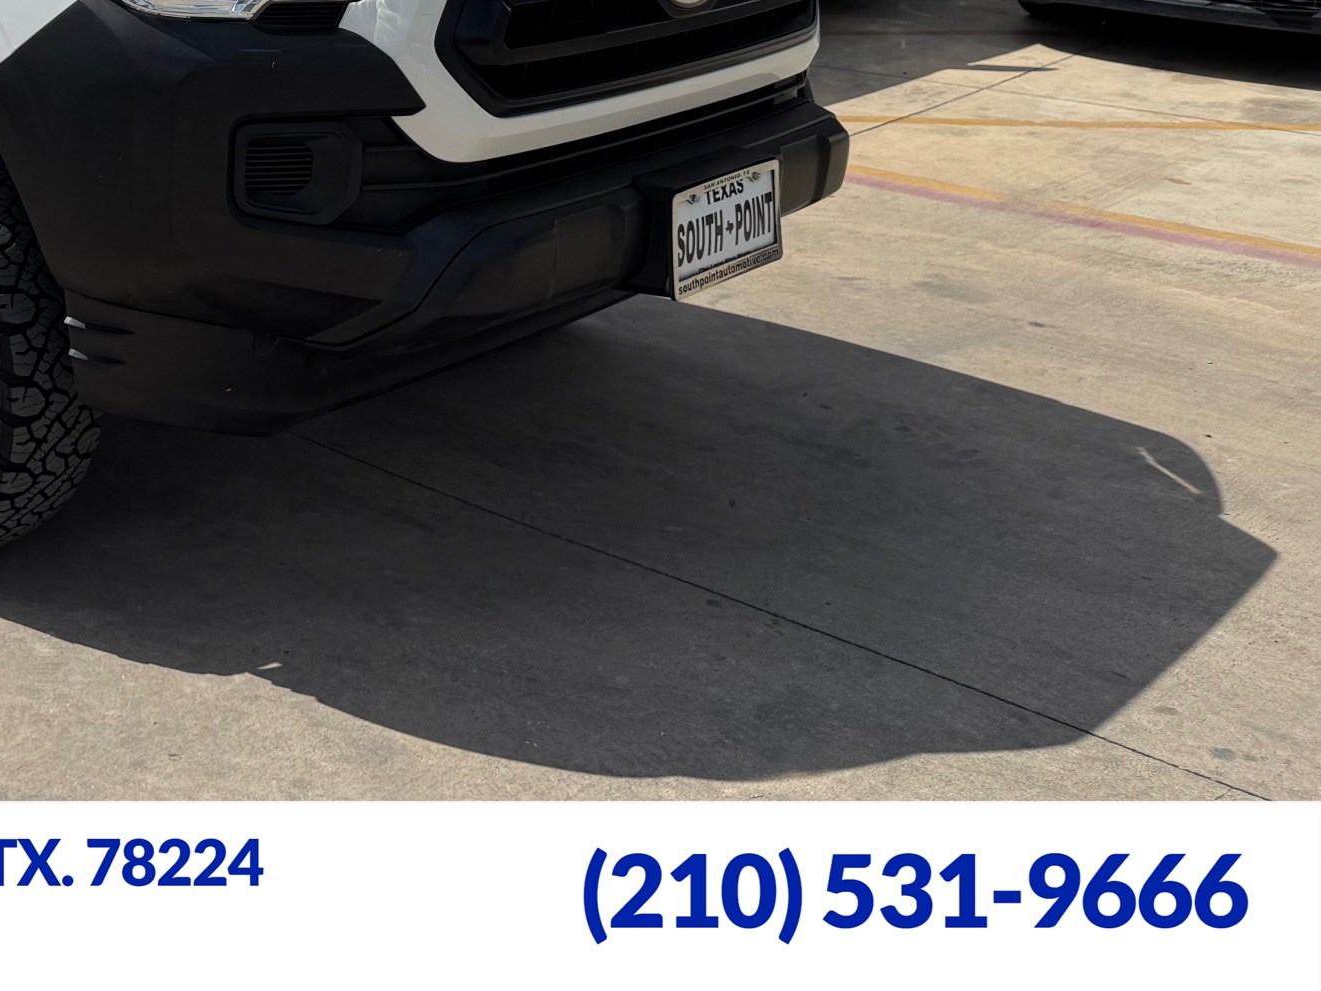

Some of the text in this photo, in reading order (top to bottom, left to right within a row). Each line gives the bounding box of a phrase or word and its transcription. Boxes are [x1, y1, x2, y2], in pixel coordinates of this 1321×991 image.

[705, 179, 744, 205] TEXAS
[678, 191, 773, 268] SOUTH POINT
[678, 248, 779, 295] southpointautomotive.com
